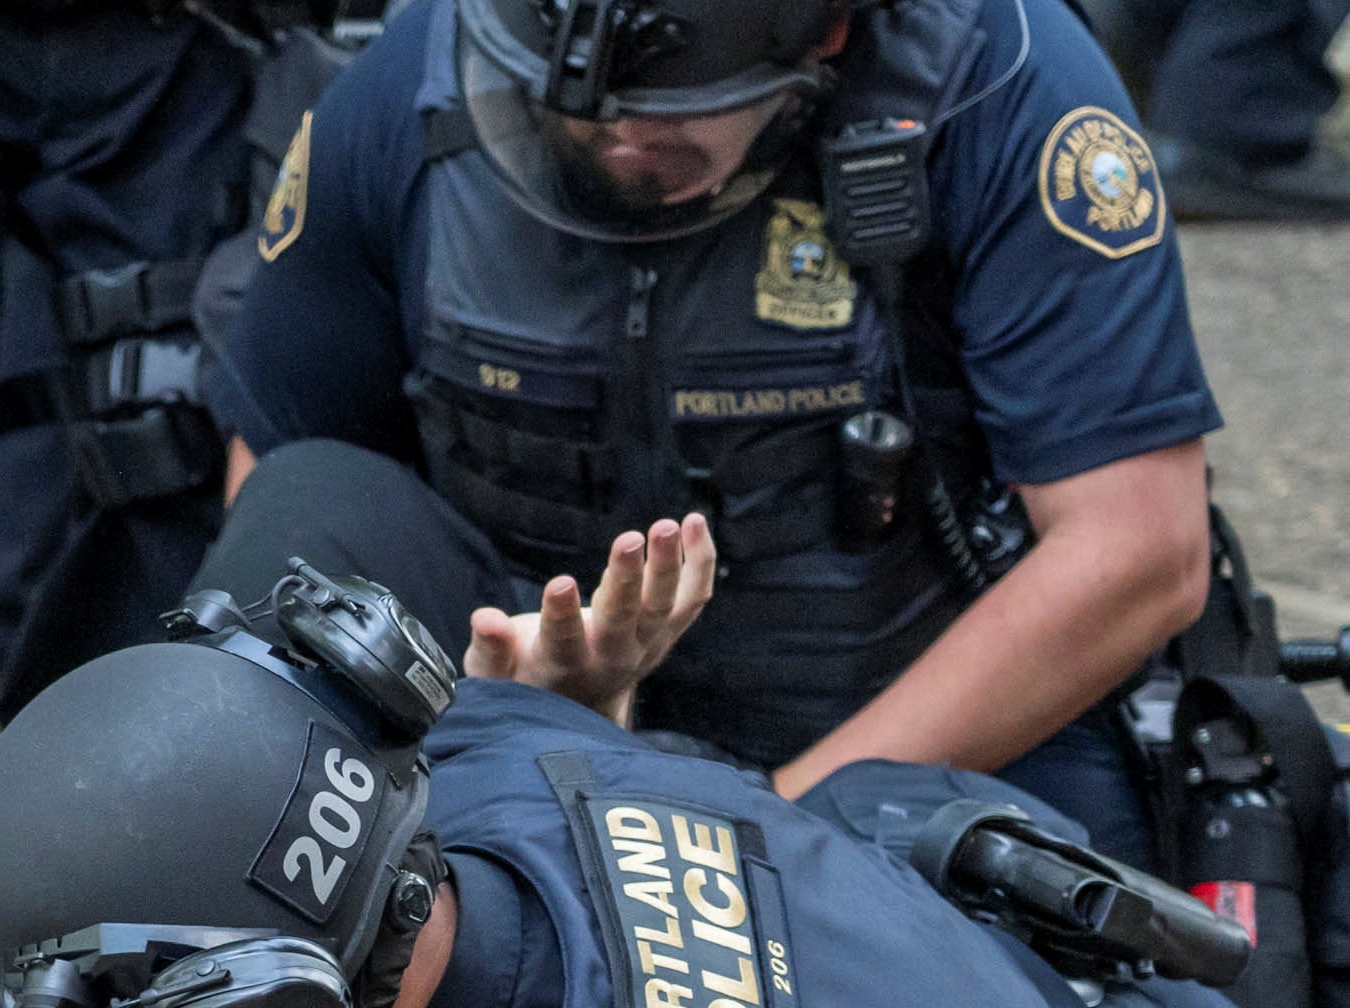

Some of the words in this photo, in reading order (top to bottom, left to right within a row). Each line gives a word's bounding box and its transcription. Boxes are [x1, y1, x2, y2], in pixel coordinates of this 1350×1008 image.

[675, 390, 785, 416] PORTLAND
[788, 380, 865, 412] POLICE
[283, 747, 375, 905] 206
[767, 940, 793, 995] 206
